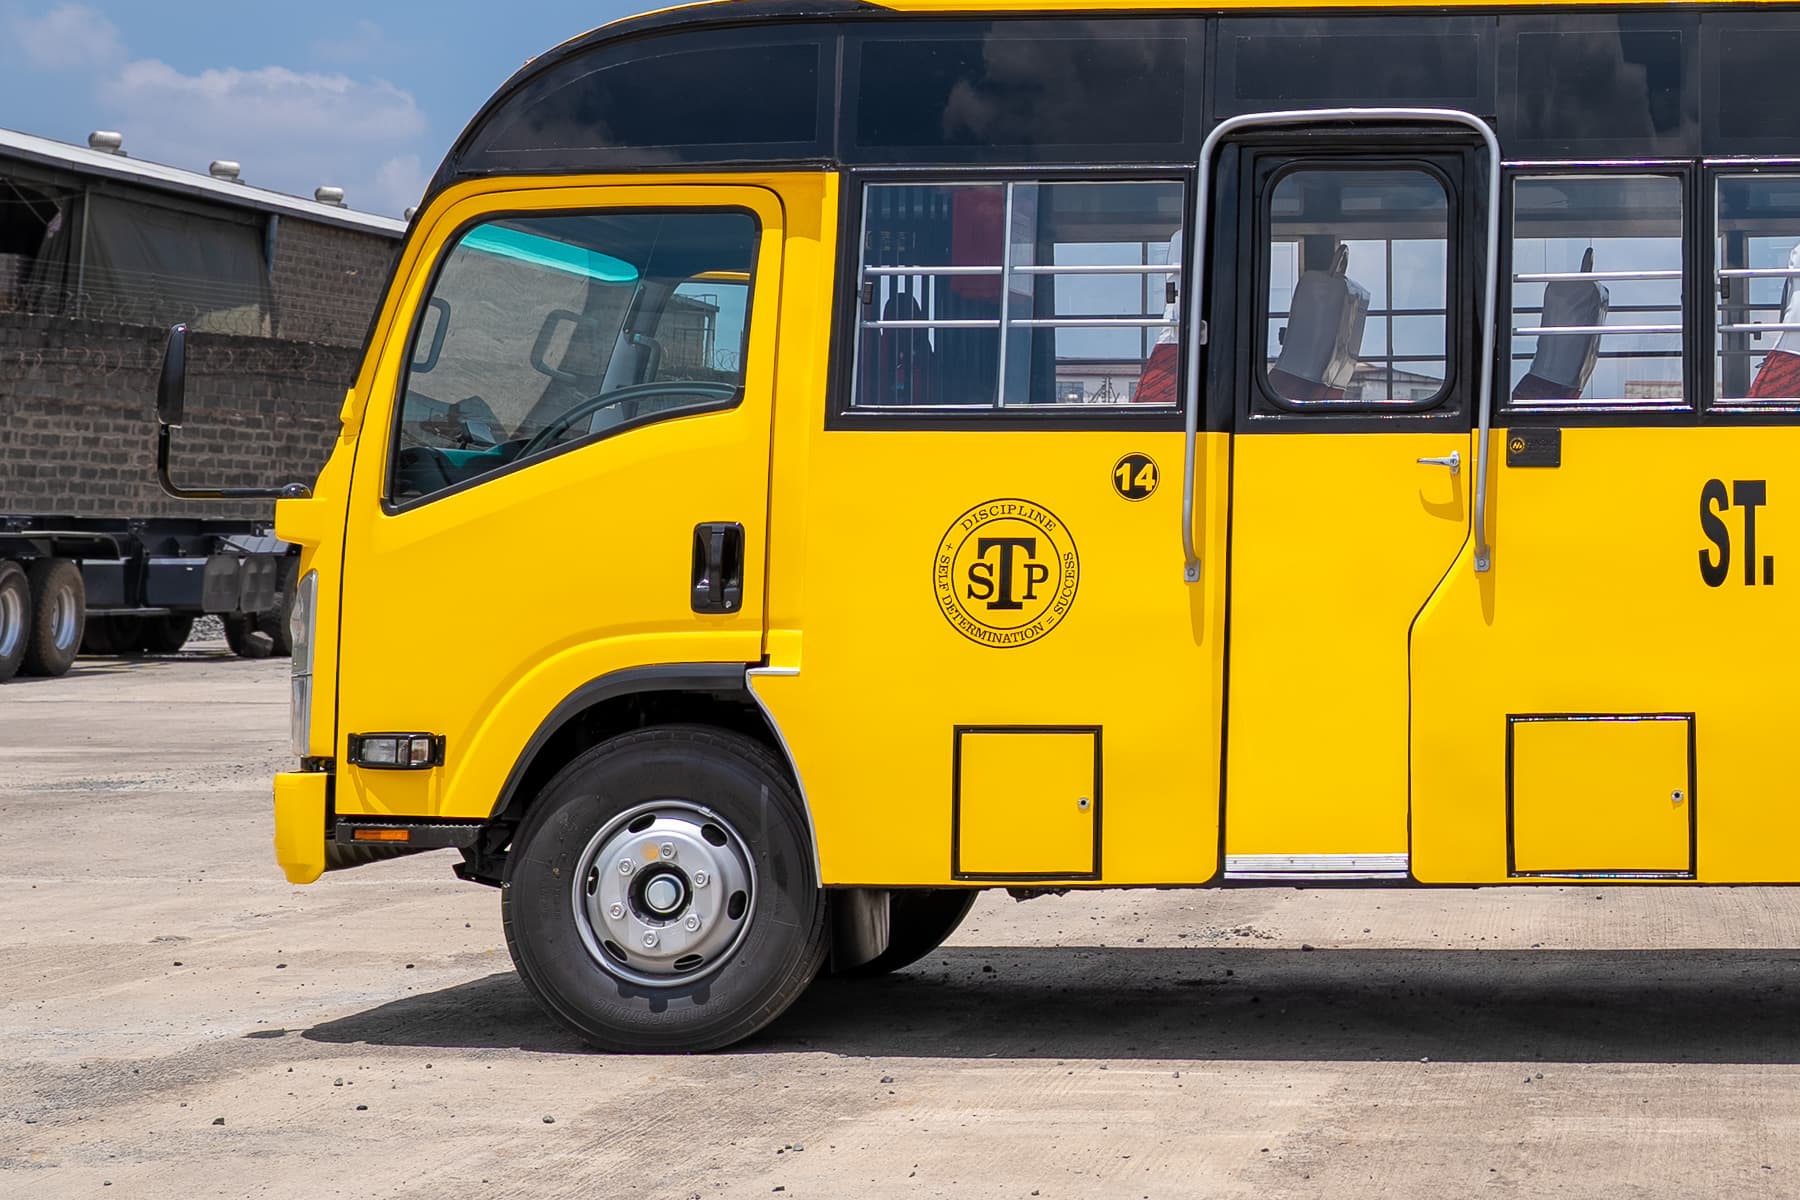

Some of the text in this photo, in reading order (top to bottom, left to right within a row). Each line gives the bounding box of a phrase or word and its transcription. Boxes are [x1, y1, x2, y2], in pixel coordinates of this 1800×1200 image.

[1115, 462, 1156, 492] 14
[961, 504, 1056, 532] DISCIPLINE
[1699, 478, 1774, 587] ST.
[938, 554, 951, 592] SELF
[1053, 552, 1075, 615] SUCCESS
[942, 594, 1044, 643] DETERMINATION
